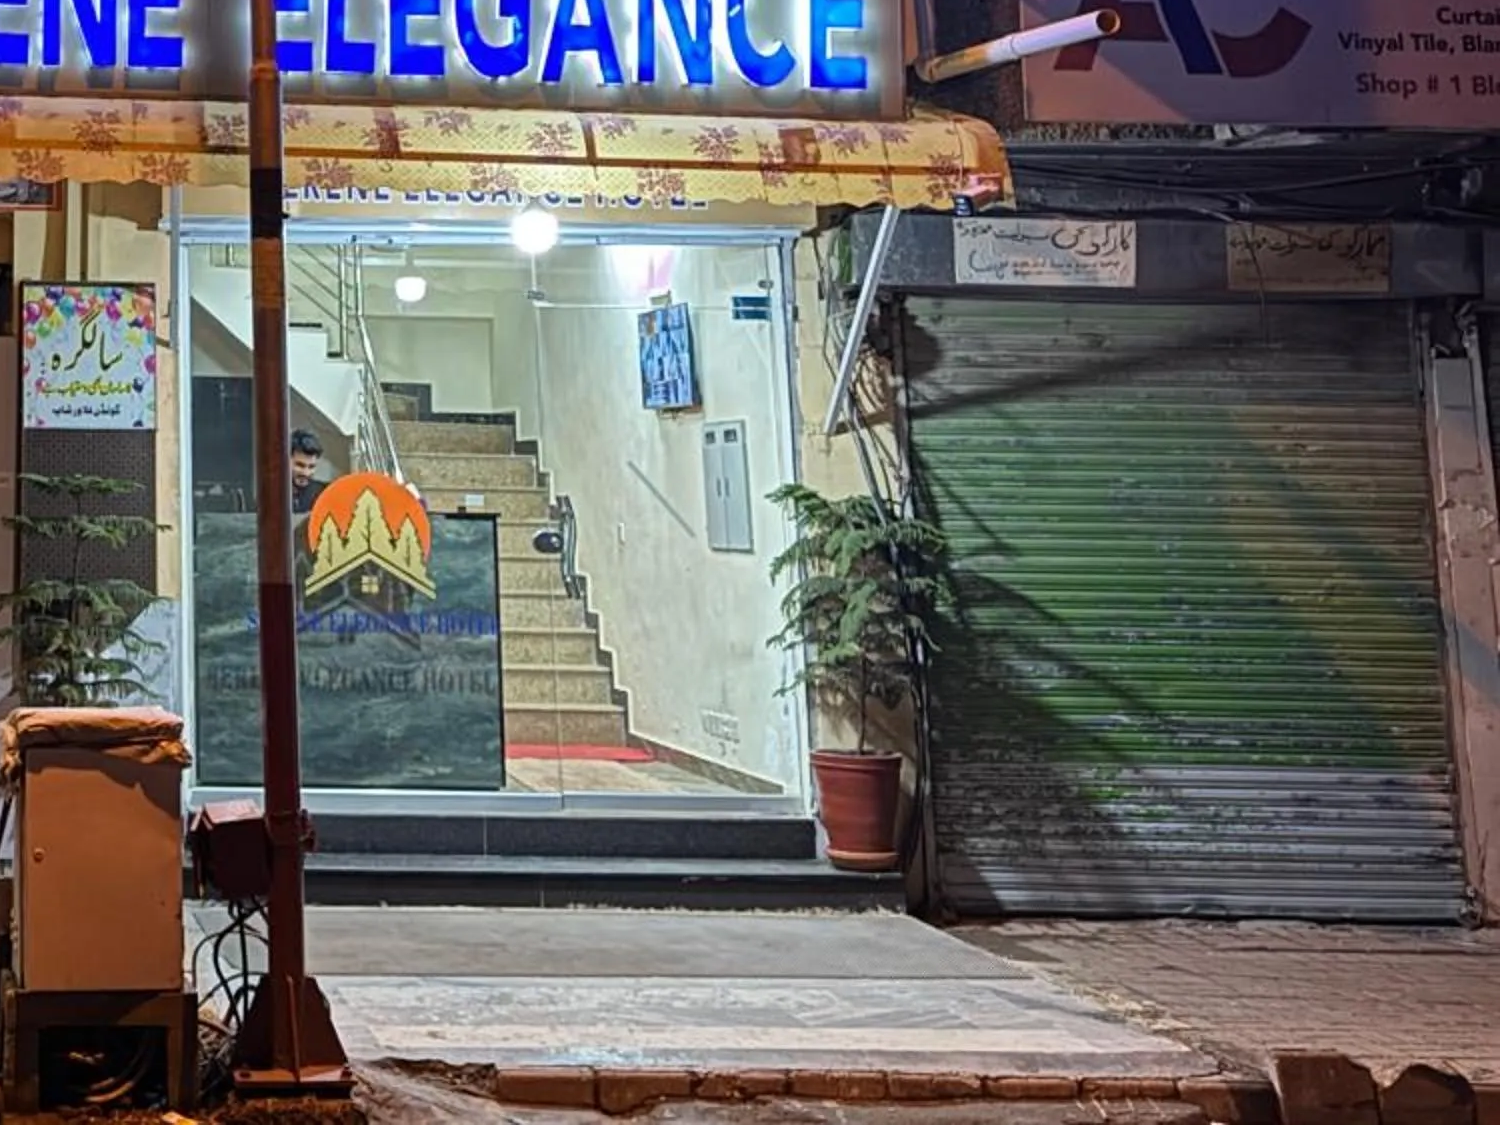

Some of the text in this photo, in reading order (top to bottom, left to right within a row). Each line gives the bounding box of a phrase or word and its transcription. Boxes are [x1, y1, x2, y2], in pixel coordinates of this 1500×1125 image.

[1337, 32, 1405, 56] Vinyal
[1410, 33, 1456, 55] Tile,
[1356, 73, 1419, 100] Shop
[1428, 75, 1440, 94] #
[1449, 75, 1461, 95] 1
